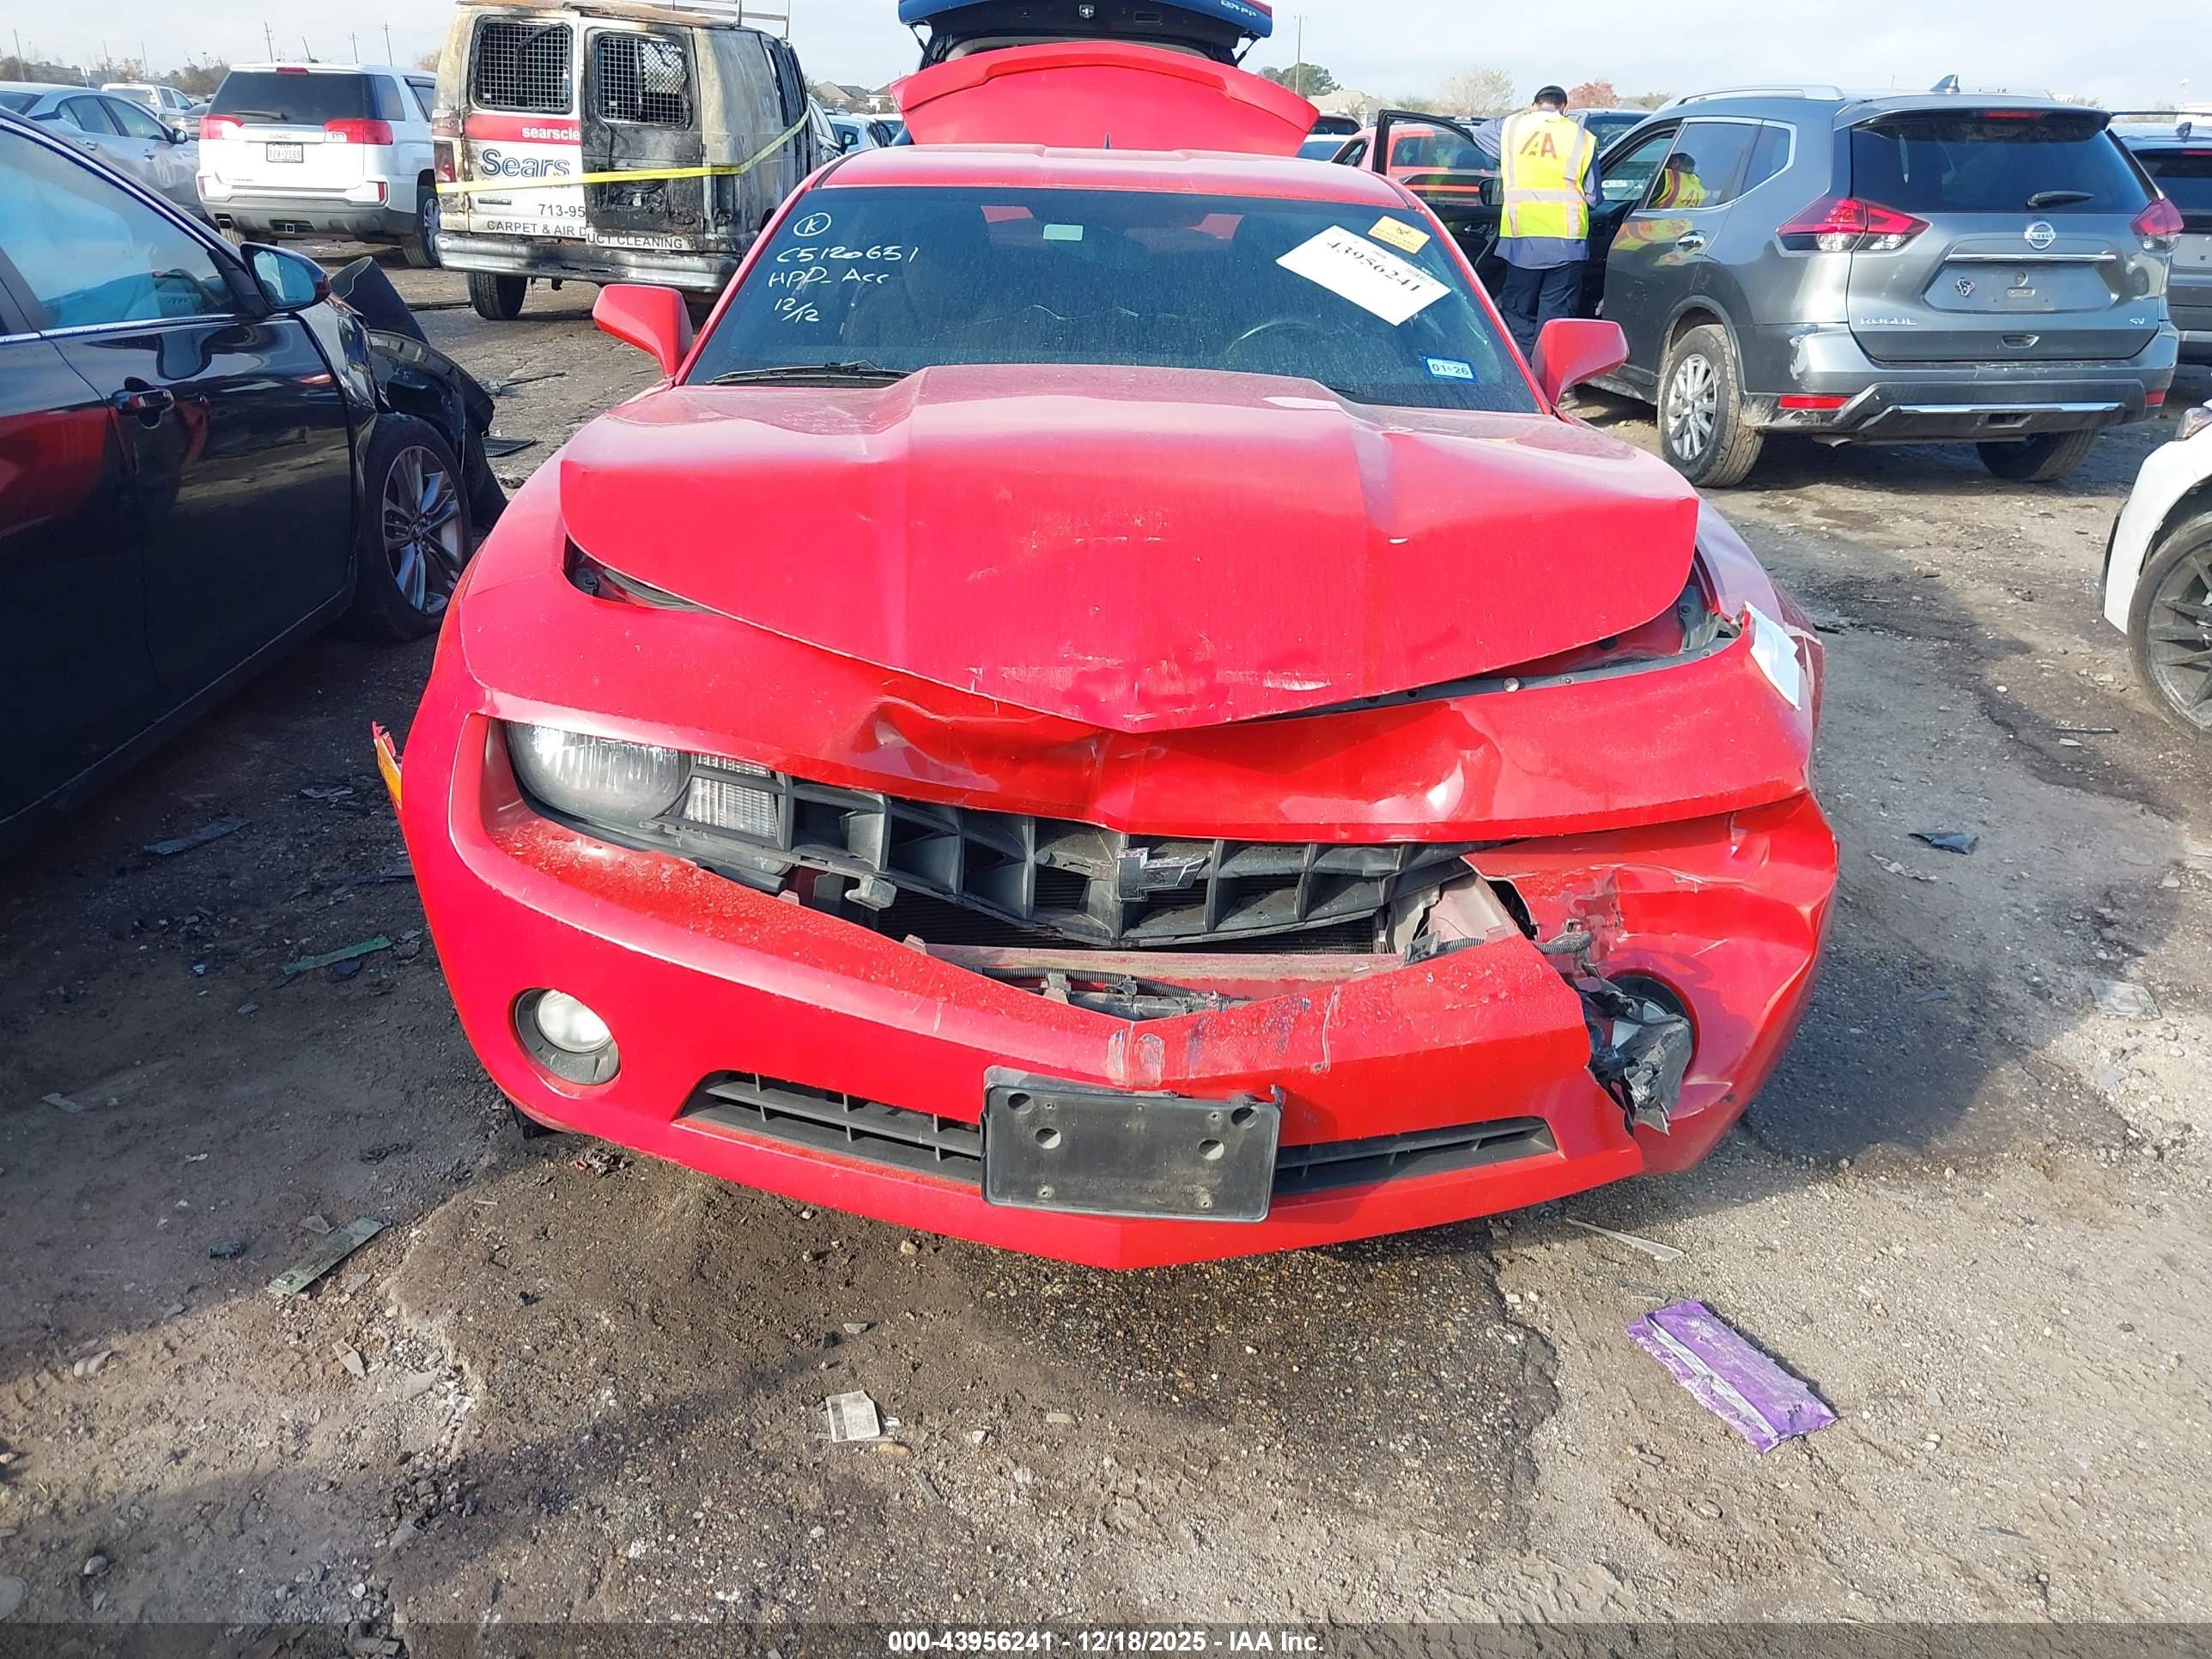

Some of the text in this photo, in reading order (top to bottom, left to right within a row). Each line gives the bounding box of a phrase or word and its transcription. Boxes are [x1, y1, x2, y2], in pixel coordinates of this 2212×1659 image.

[481, 148, 570, 178] Sears
[538, 203, 586, 218] 713-95
[486, 220, 538, 234] CARPET
[542, 224, 550, 234] &
[554, 224, 575, 236] AIR
[617, 234, 684, 249] CLEANING
[1326, 241, 1421, 291] 43956241
[774, 297, 821, 324] 12/12
[1860, 316, 1918, 325] ROGUE
